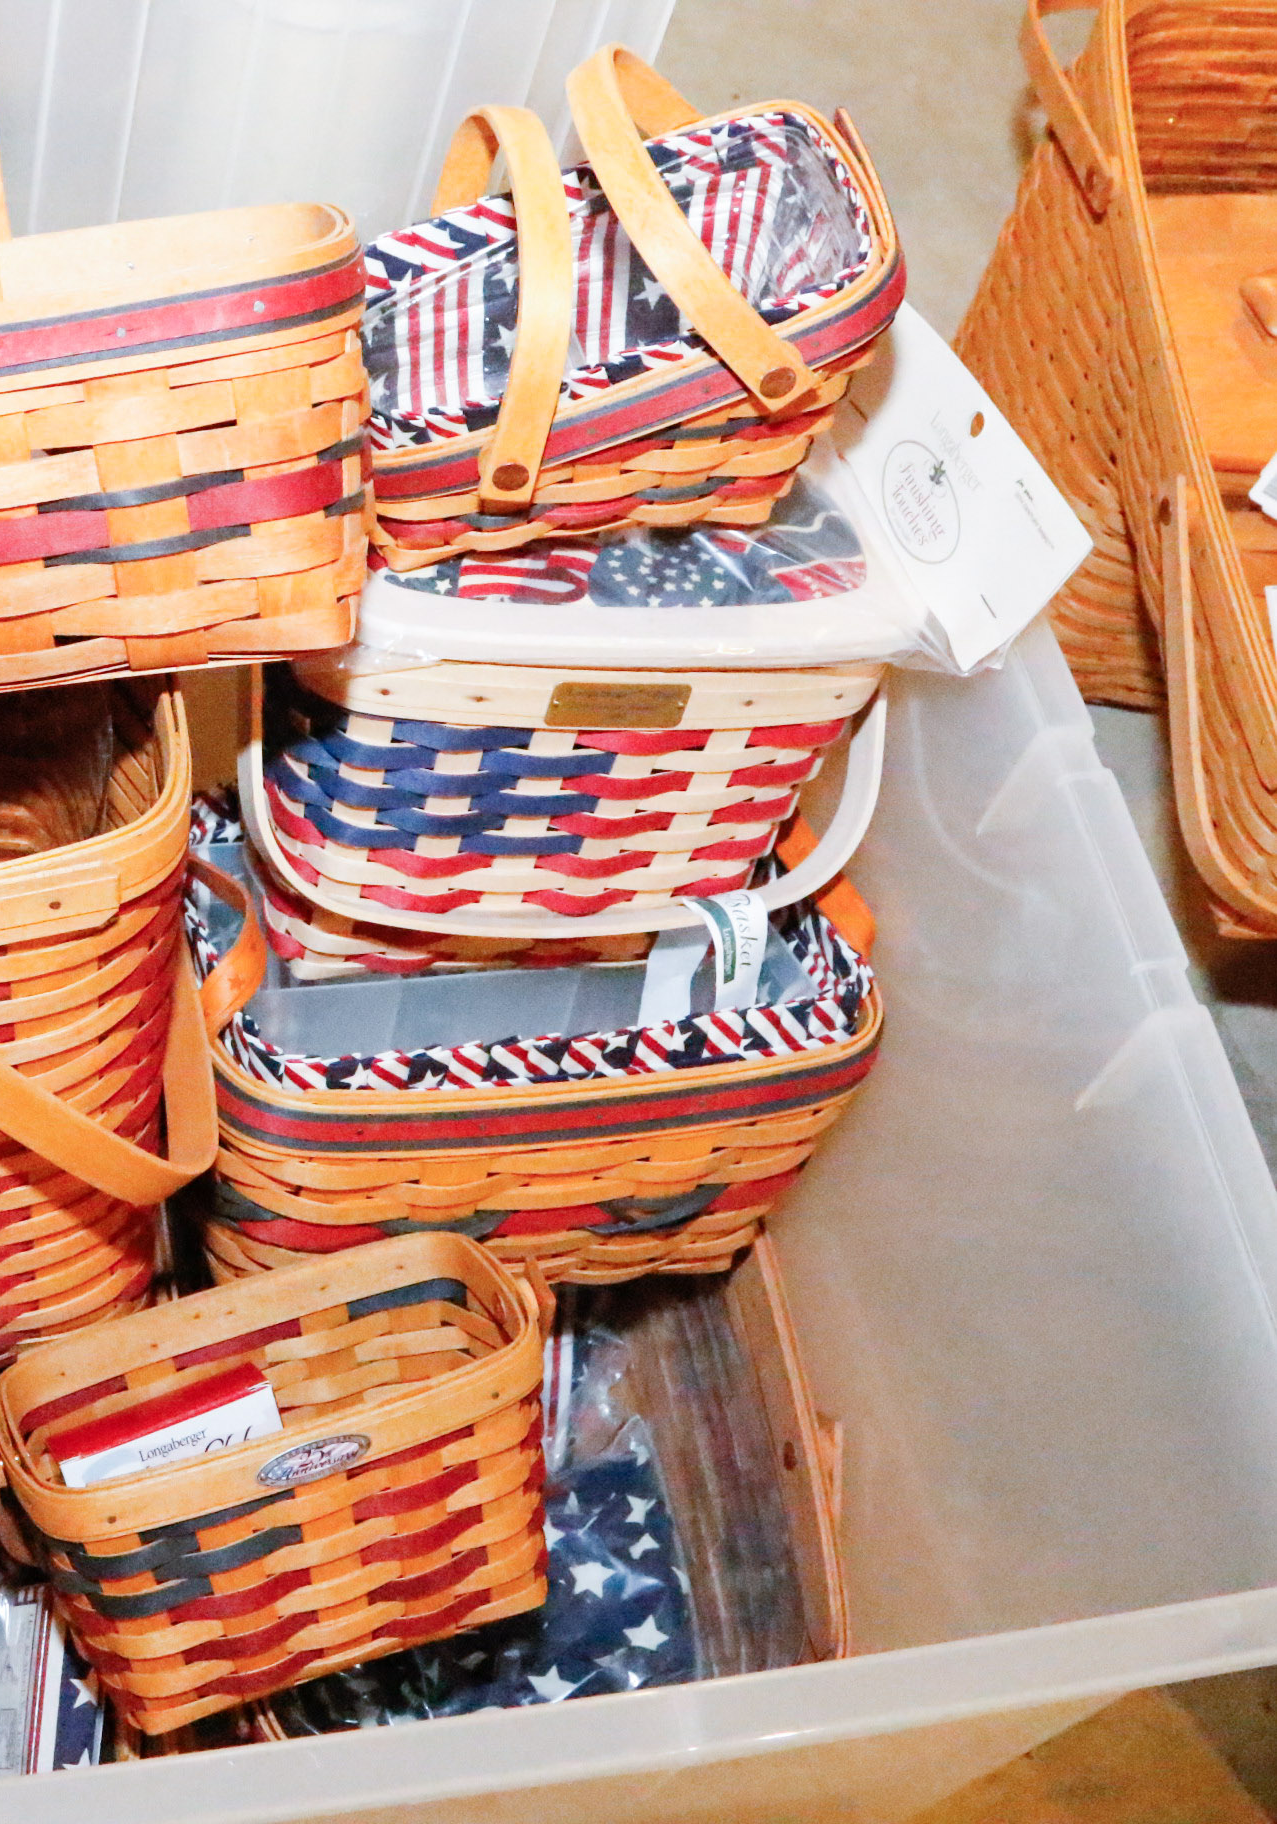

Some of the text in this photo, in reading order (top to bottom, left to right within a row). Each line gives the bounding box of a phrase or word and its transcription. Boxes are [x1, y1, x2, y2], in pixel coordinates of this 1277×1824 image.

[891, 484, 929, 546] Touches
[898, 461, 946, 541] Finishing
[725, 893, 759, 968] Basket
[138, 1428, 208, 1462] Longaberger
